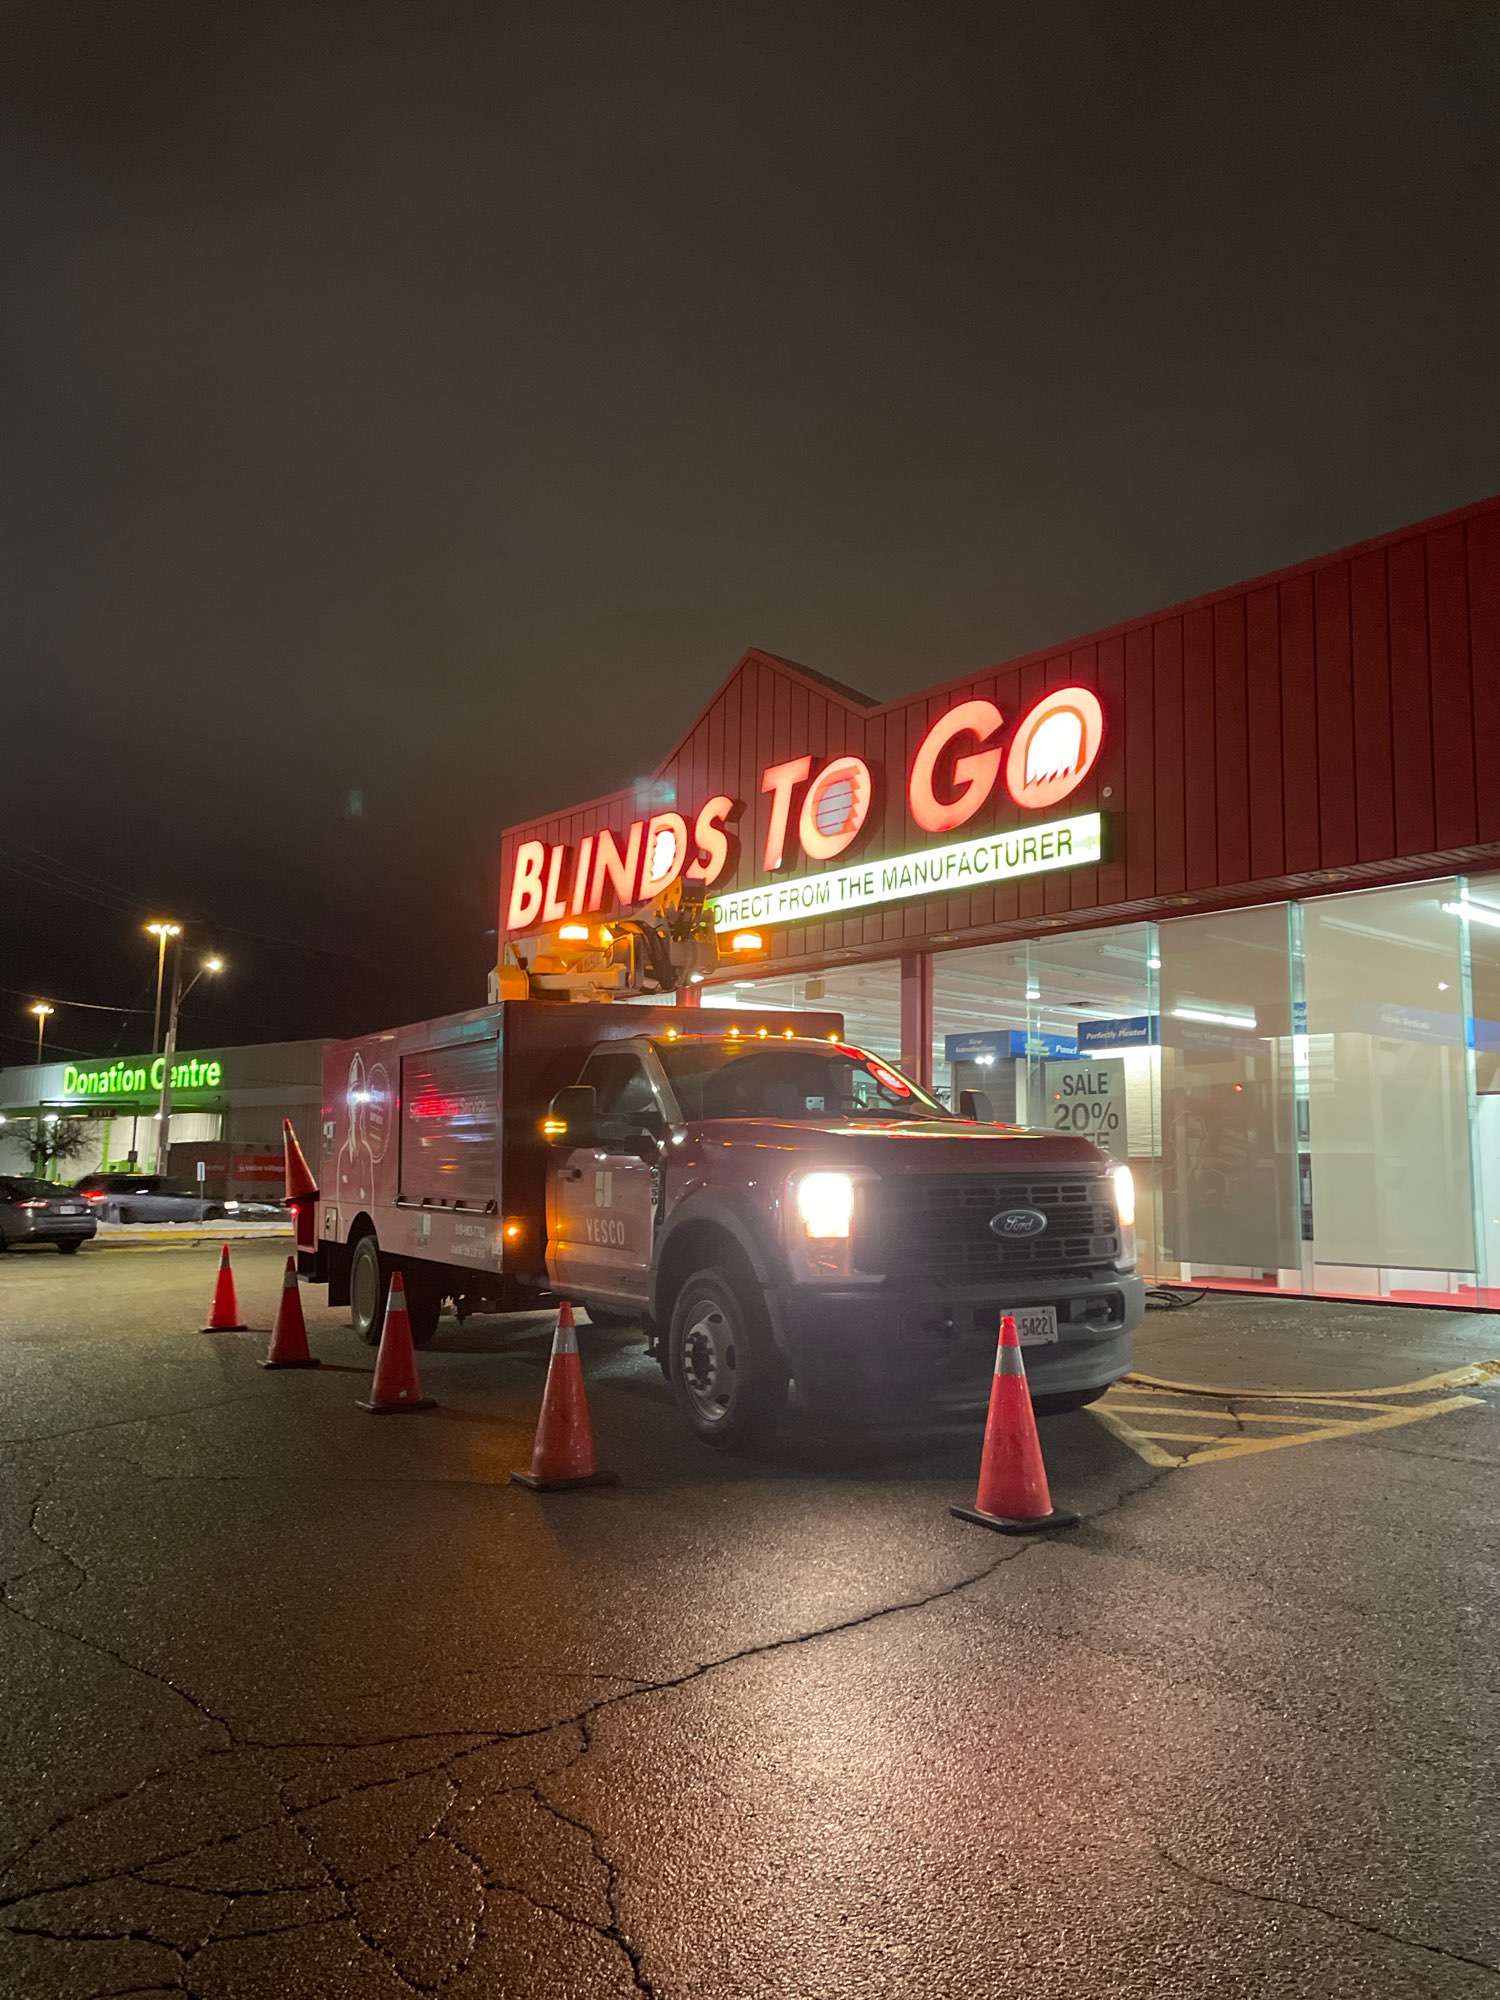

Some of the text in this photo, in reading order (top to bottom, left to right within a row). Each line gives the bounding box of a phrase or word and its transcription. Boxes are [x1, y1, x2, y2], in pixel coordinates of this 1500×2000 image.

[506, 687, 1104, 931] BLINDS TO GO
[713, 827, 1073, 926] DIRECT FROM THE MANUFACTURER
[1086, 1028, 1147, 1040] Perfectly Pleated
[63, 1057, 221, 1095] Donation Centre
[1062, 1072, 1108, 1096] SALE
[1053, 1101, 1119, 1131] 20%
[586, 1218, 625, 1245] YESCO
[1004, 1215, 1034, 1231] Ford
